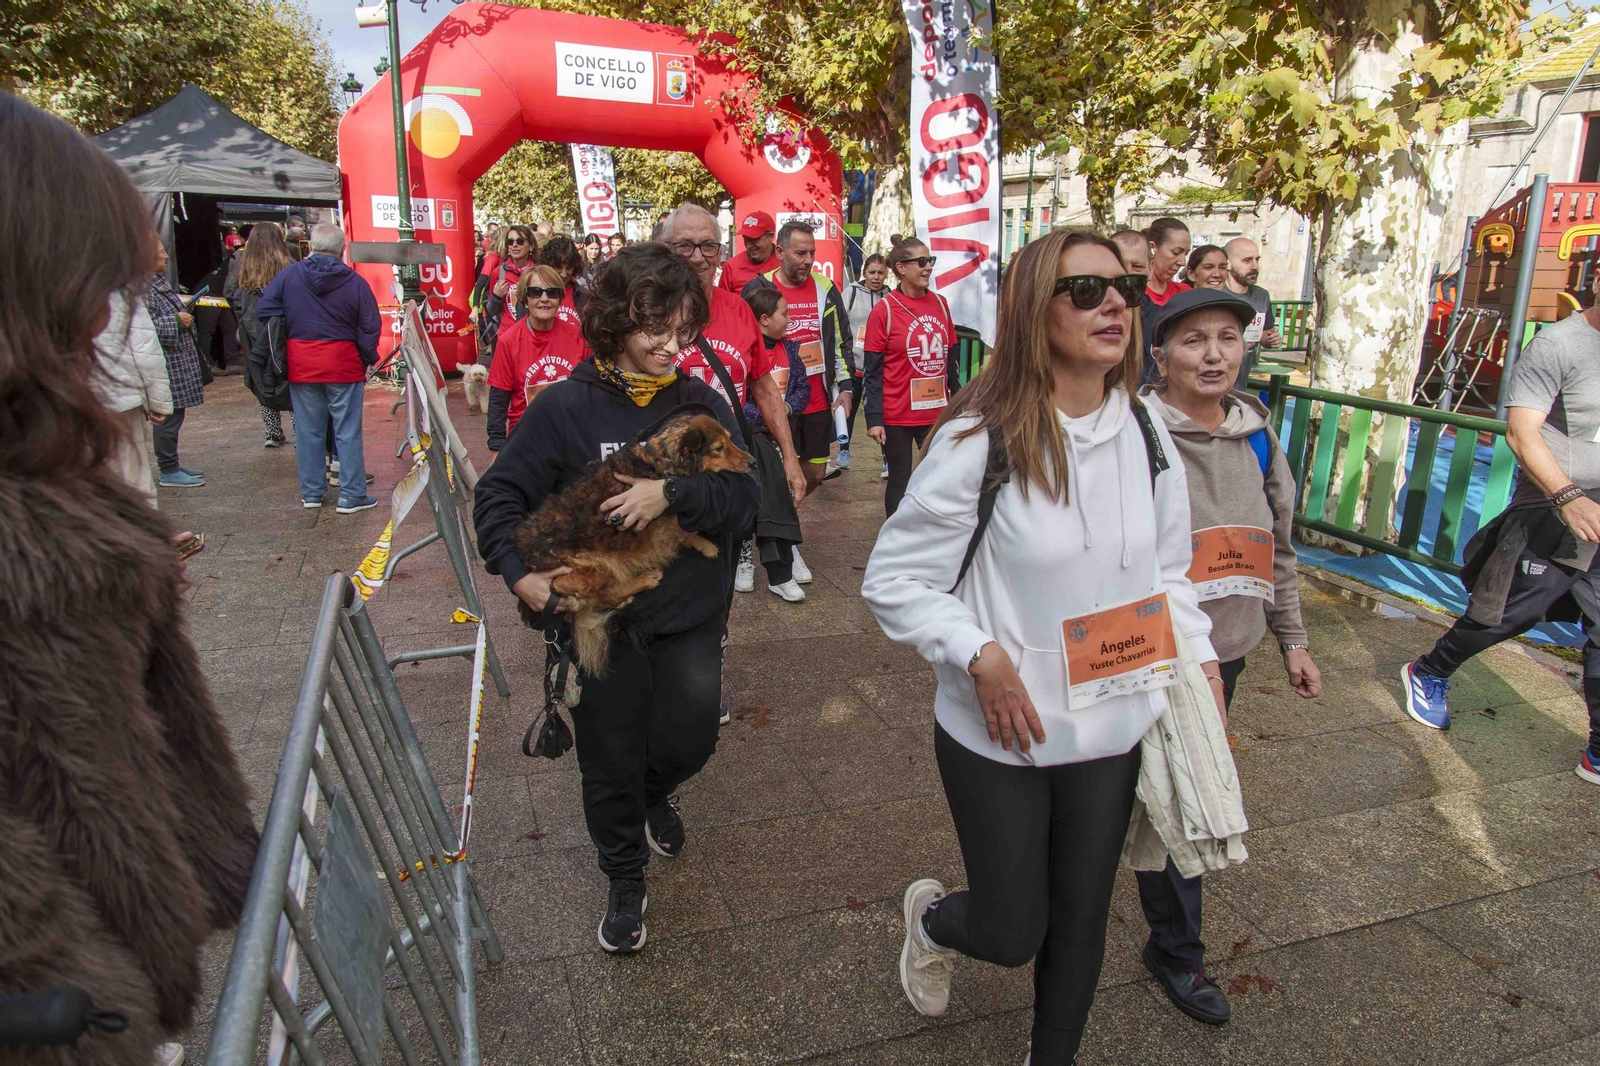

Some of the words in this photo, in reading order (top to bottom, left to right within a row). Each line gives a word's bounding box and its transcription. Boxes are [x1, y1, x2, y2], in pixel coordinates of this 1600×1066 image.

[921, 0, 939, 81] depo
[564, 54, 646, 74] CONCELLO
[575, 72, 595, 87] DE
[600, 74, 637, 90] VIGO
[920, 93, 990, 290] VIGO
[376, 203, 430, 213] CONLLO
[383, 213, 396, 221] DE
[426, 309, 454, 319] ellor
[391, 318, 454, 333] dorte
[917, 333, 944, 361] 14
[1148, 424, 1163, 459] Quechua
[1217, 550, 1243, 561] Julia
[1208, 562, 1233, 573] Besada
[1235, 562, 1254, 570] Brao
[1135, 600, 1163, 620] 1389
[1101, 635, 1146, 655] Ángeles
[1089, 658, 1115, 671] Yuste
